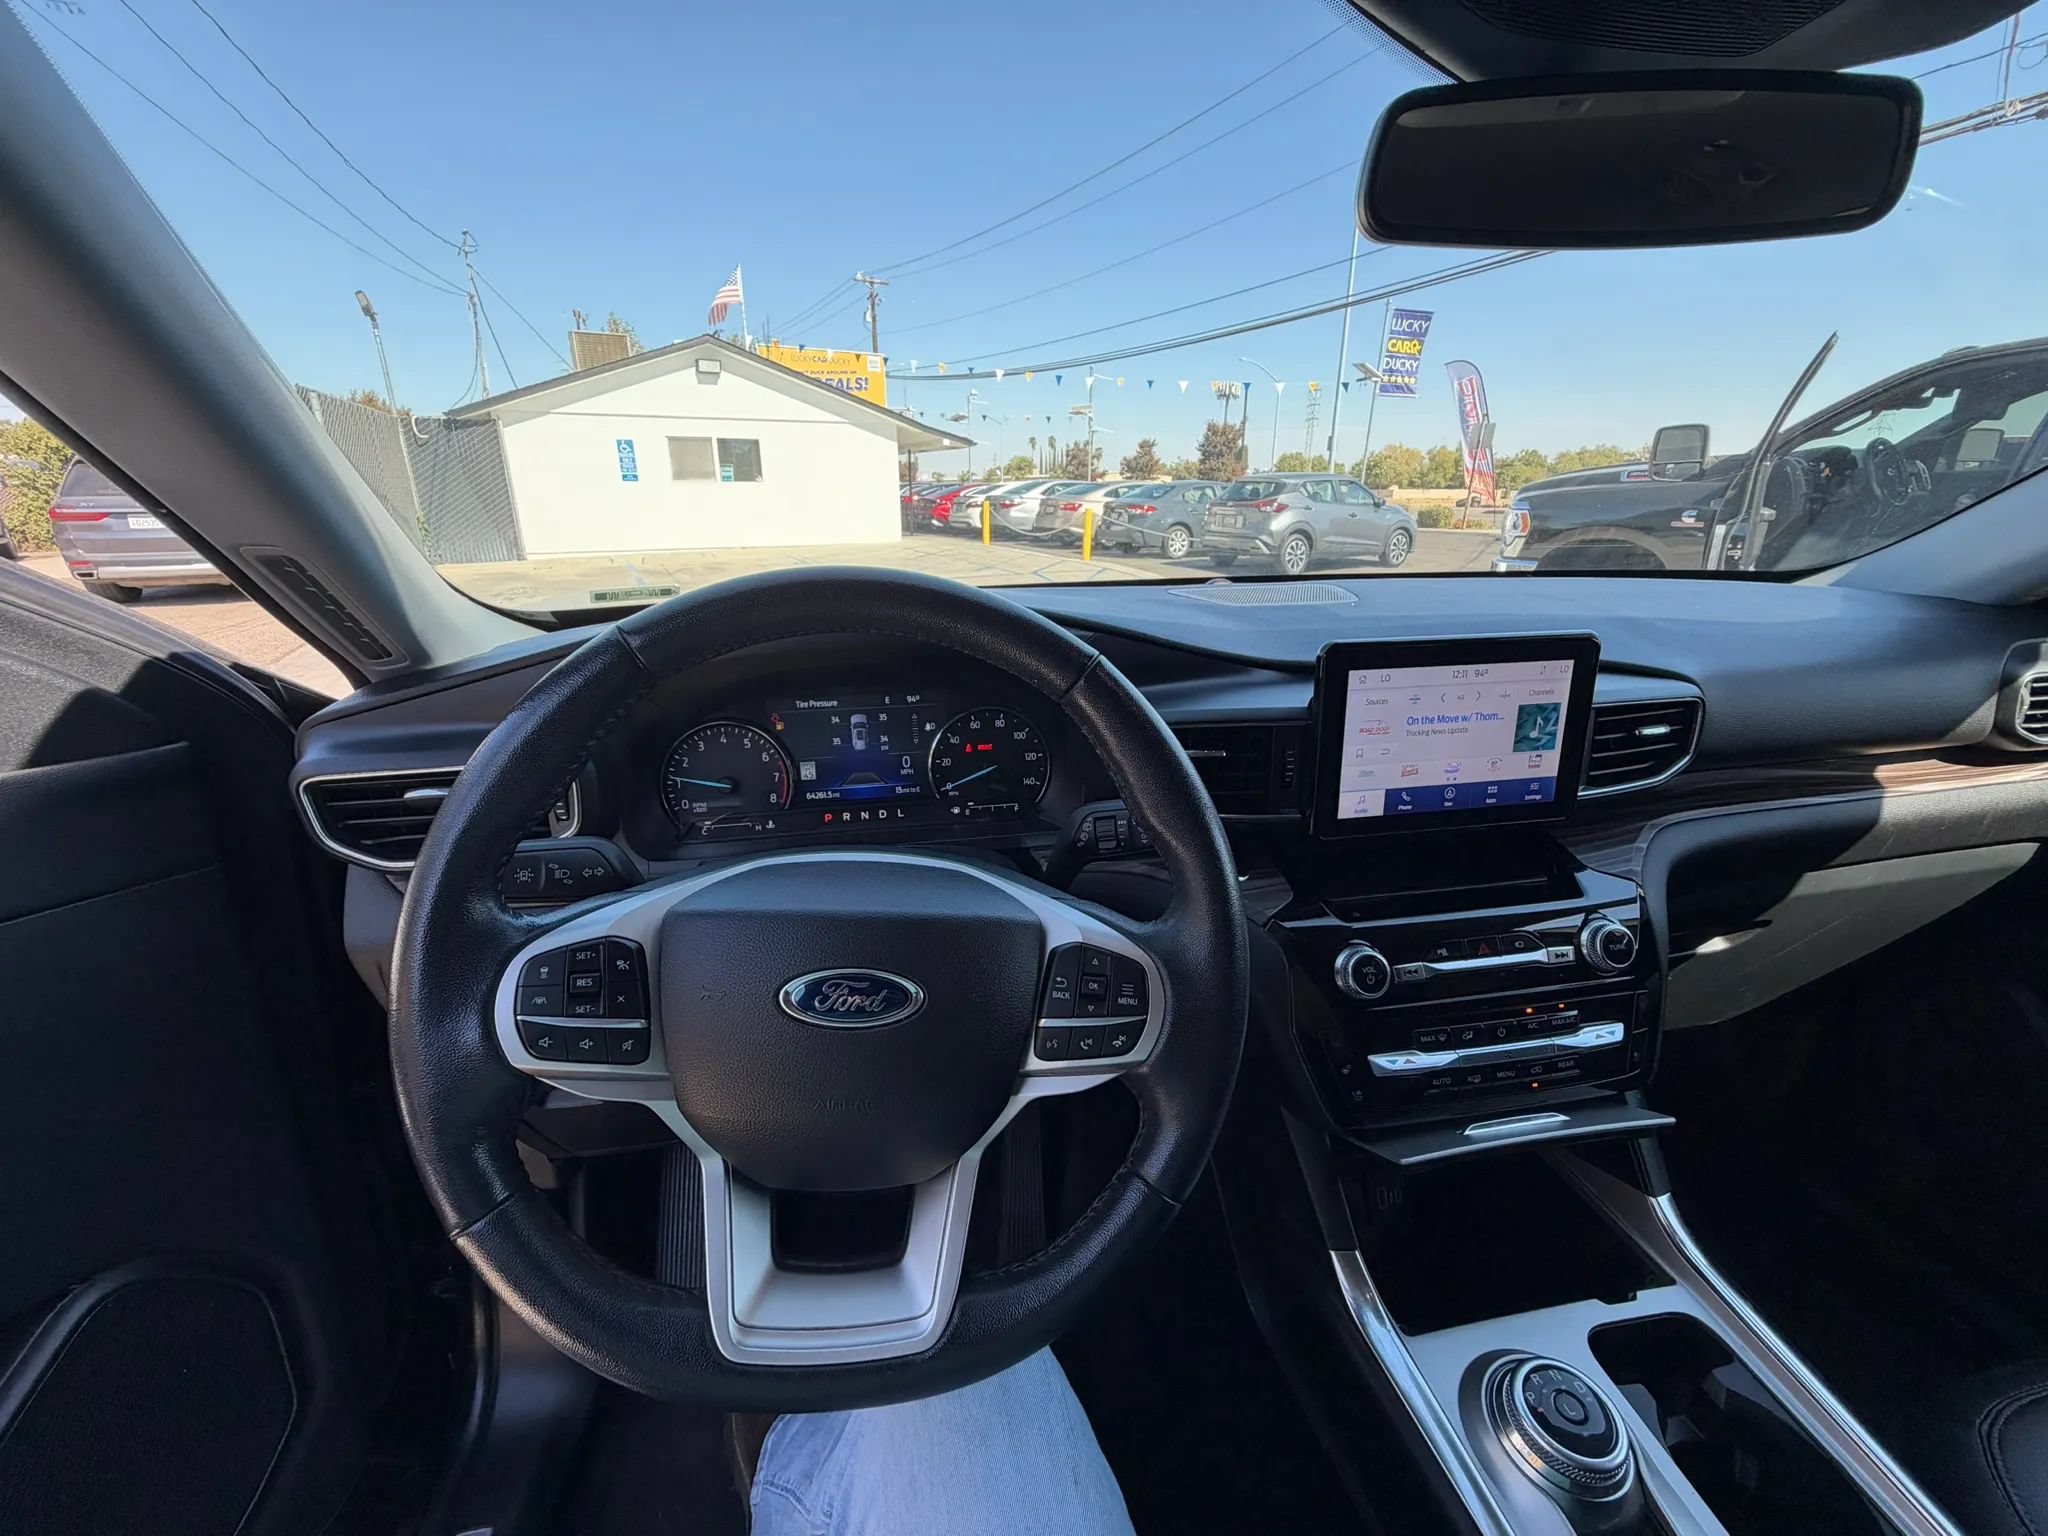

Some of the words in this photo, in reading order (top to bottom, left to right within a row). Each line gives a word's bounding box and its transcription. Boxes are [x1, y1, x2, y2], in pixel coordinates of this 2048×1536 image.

[1392, 319, 1430, 332] LUCKY
[1383, 357, 1419, 371] DUCKY
[822, 377, 868, 392] EALS!
[1452, 670, 1468, 678] 12:11
[1560, 665, 1569, 673] LO
[1380, 674, 1390, 682] LO
[1529, 688, 1554, 696] Channels
[810, 700, 838, 708] Pressure
[995, 720, 1005, 728] 80
[1407, 716, 1419, 726] On
[1421, 715, 1434, 725] the
[1436, 714, 1459, 724] Move
[1460, 712, 1473, 722] w/
[970, 721, 980, 729] 60
[720, 734, 727, 744] 4
[950, 736, 960, 744] 40
[1013, 732, 1026, 740] 100
[698, 741, 704, 751] 3
[744, 739, 751, 748] 5
[682, 757, 689, 767] 2
[762, 752, 769, 762] 6
[902, 756, 910, 768] 0
[773, 772, 780, 782] 7
[1023, 777, 1035, 785] 140
[770, 793, 777, 803] 8
[681, 800, 689, 809] 0
[824, 813, 832, 822] P
[842, 812, 851, 821] R
[861, 811, 869, 820] N
[879, 810, 887, 819] D
[897, 809, 904, 817] L
[576, 952, 596, 960] SET+
[576, 978, 592, 987] RES
[814, 980, 888, 1012] Ford
[1052, 991, 1070, 999] BACK
[1118, 997, 1138, 1005] MENU
[1432, 1077, 1451, 1085] AUTO
[1530, 1373, 1543, 1385] R
[1549, 1369, 1562, 1381] N
[1574, 1381, 1586, 1393] D
[1526, 1392, 1536, 1405] P
[1563, 1404, 1576, 1415] L
